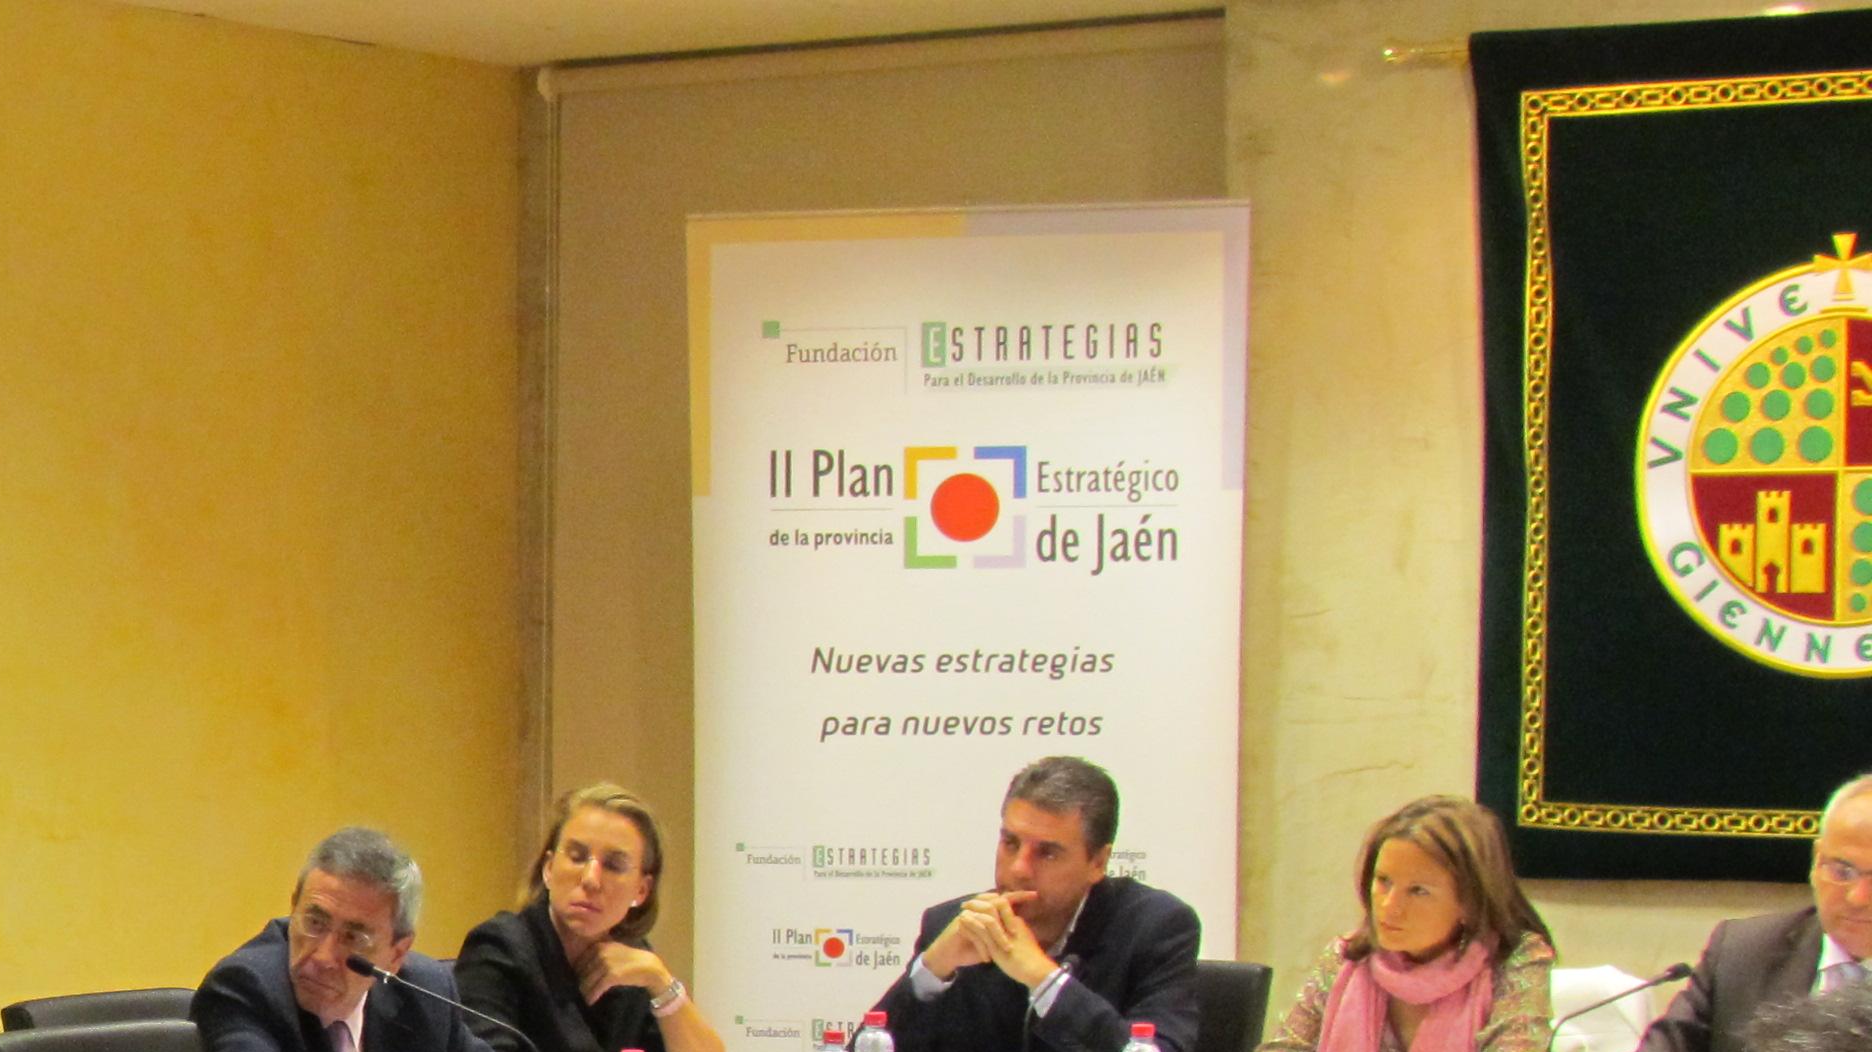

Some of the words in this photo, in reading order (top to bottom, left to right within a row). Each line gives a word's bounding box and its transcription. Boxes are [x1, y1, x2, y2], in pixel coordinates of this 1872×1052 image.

[785, 342, 898, 364] Fundación
[927, 322, 1163, 364] ESTRATEGIAS
[924, 373, 950, 388] Para
[954, 372, 964, 386] el
[968, 371, 1027, 387] Desarrollo
[1030, 371, 1044, 386] de
[1048, 370, 1059, 385] la
[1063, 370, 1116, 385] Provincia
[1120, 369, 1134, 384] de
[812, 448, 894, 498] Plan
[1037, 459, 1179, 503] Estratégico
[769, 528, 790, 546] de
[795, 528, 810, 546] la
[814, 528, 894, 551] provincia
[1036, 513, 1080, 562] de
[1091, 513, 1178, 576] Jaén
[811, 646, 927, 674] Nuevas
[935, 646, 1115, 680] estrategias
[820, 715, 892, 743] para
[901, 716, 1014, 736] nuevos
[1021, 711, 1104, 736] retos
[786, 928, 813, 945] Plan
[856, 950, 870, 966] de
[873, 950, 901, 970] Jaén
